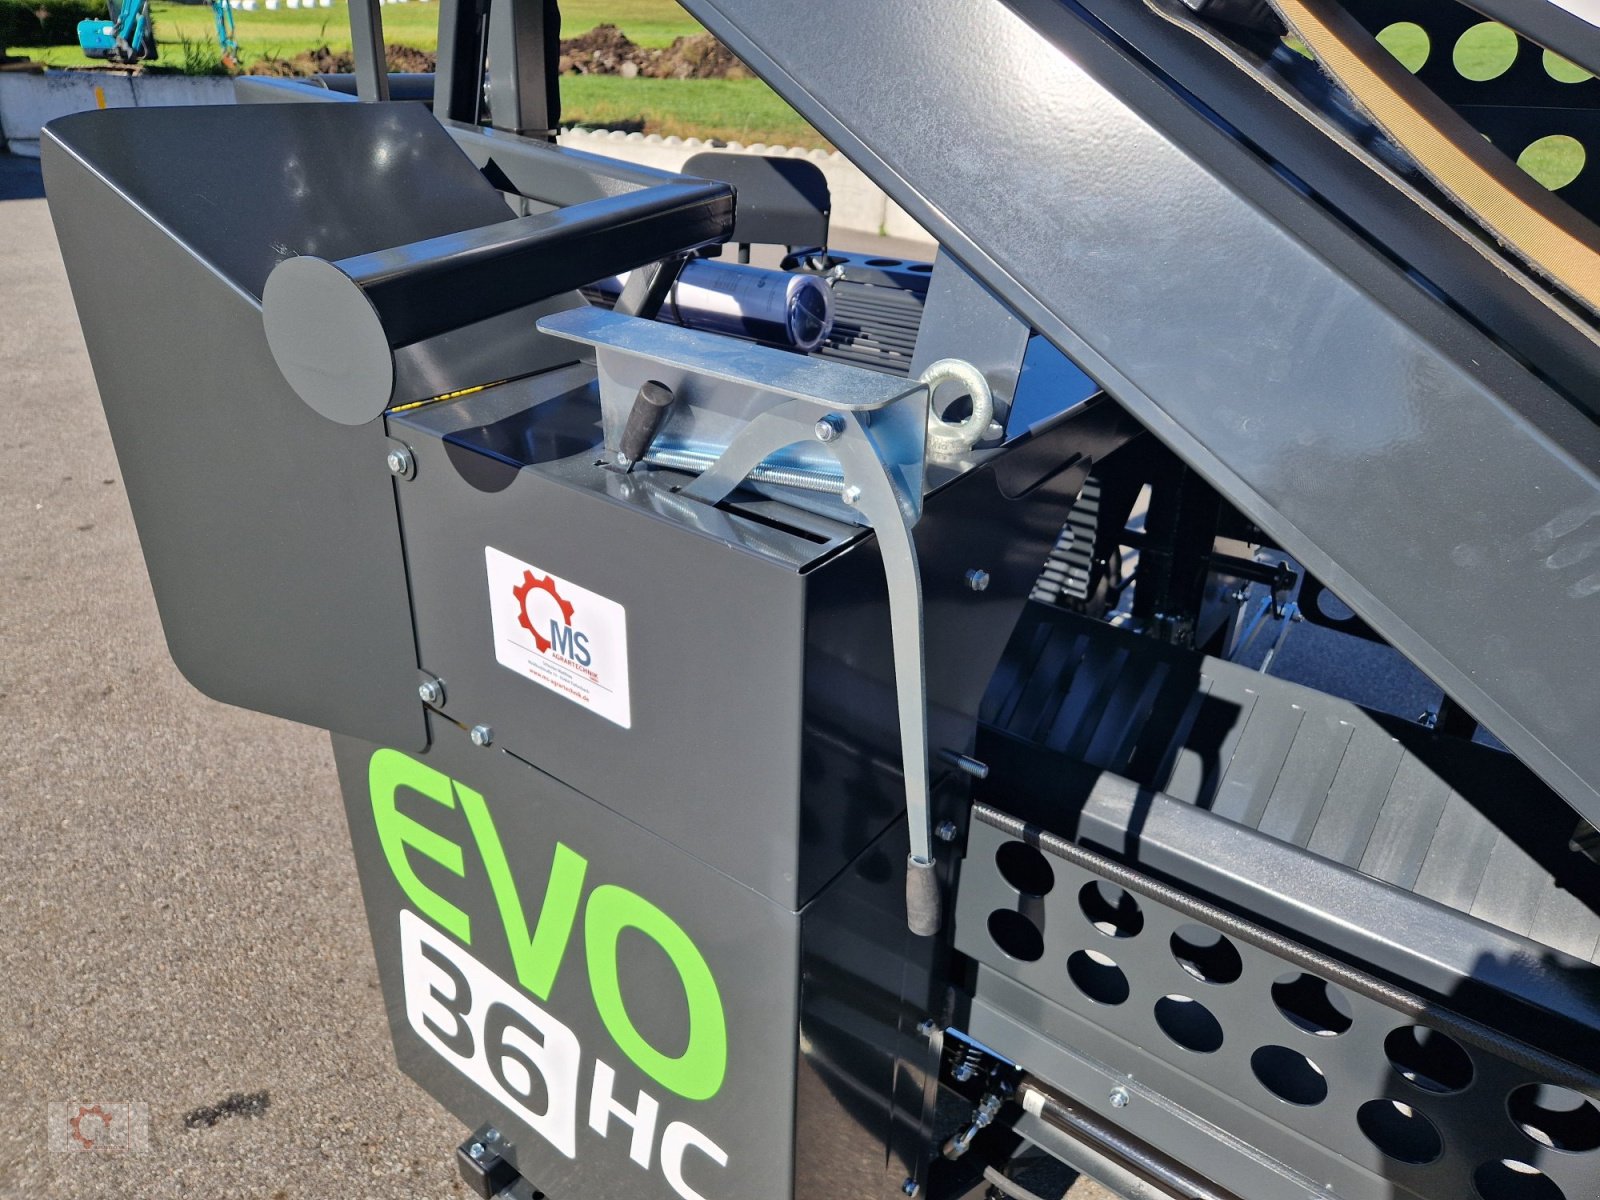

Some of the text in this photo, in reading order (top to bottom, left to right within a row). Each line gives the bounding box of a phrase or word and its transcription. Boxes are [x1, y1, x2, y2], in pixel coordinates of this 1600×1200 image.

[550, 618, 592, 667] MS
[552, 652, 599, 680] AGRARTECHNIK
[368, 748, 728, 1101] EVO
[419, 939, 729, 1200] 36 HC
